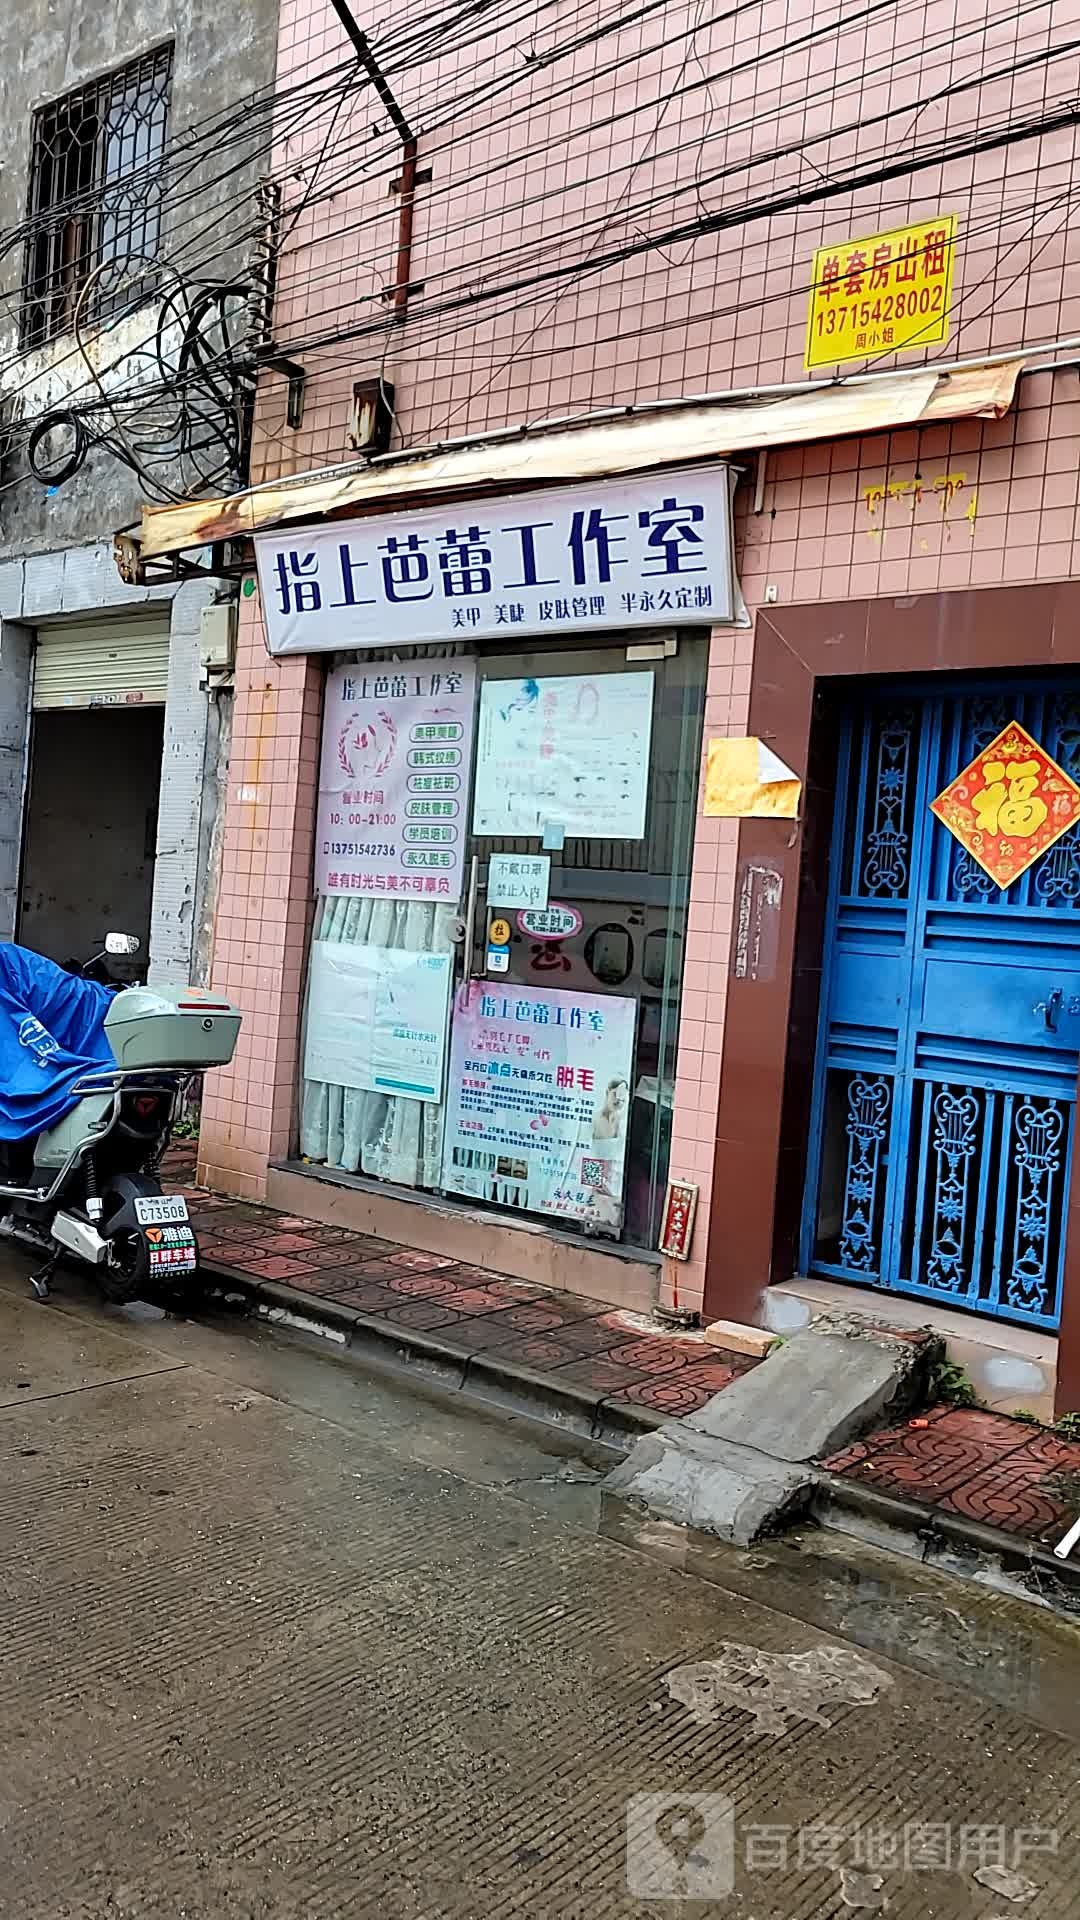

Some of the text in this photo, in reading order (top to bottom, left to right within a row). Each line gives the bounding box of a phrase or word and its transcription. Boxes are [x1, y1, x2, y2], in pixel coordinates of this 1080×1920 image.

[819, 229, 947, 302] 单套房出租
[816, 285, 943, 337] 13715428002
[855, 327, 894, 349] 周小姐
[273, 497, 707, 615] 指上芭蕾工作室
[451, 584, 713, 628] 美甲 美睫 皮肤管理 半永久定制
[342, 671, 464, 701] 指上芭蕾工作室
[343, 790, 384, 804] 营业时间
[971, 759, 1048, 838] 福
[409, 802, 453, 815] 皮肤管理
[409, 827, 452, 840] 学员培训
[331, 843, 396, 856] 13751542736
[407, 852, 450, 866] 永久脱毛
[497, 862, 542, 876] 不戴口罩
[496, 884, 540, 899] 禁止入内
[526, 913, 574, 928] 营业时间
[481, 996, 604, 1032] 指上芭蕾工作室
[141, 1205, 185, 1220] C73508
[161, 1226, 194, 1242] 雅迪
